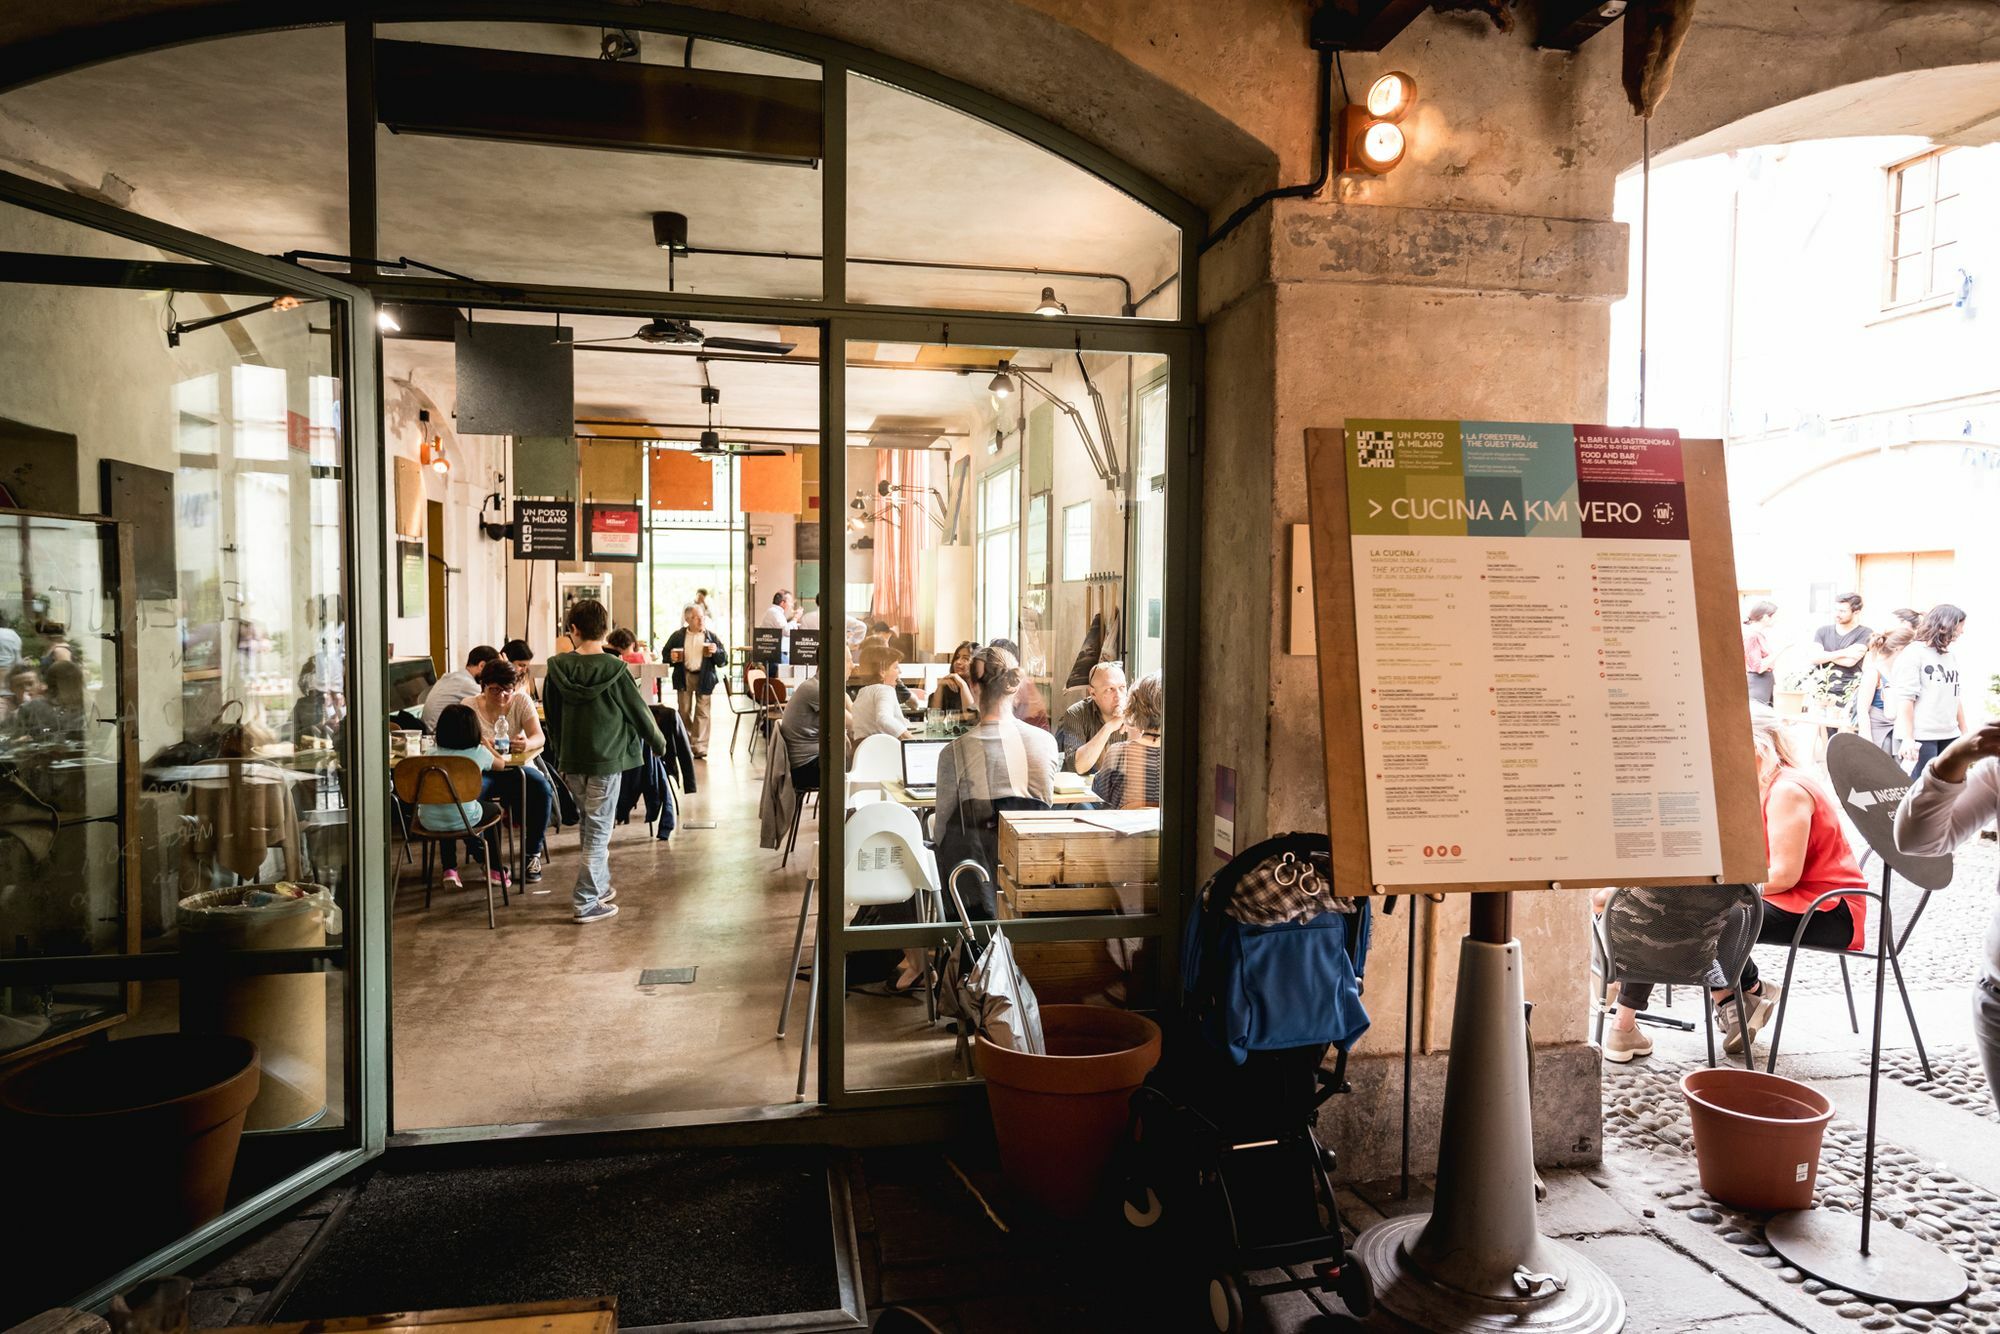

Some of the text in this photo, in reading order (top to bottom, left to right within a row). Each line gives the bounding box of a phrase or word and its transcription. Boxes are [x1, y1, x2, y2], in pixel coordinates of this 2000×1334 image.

[1397, 432, 1444, 440] UN POSTO
[1622, 438, 1670, 446] GASTRONOMIA
[1391, 498, 1642, 524] CUCINA A KM VERO
